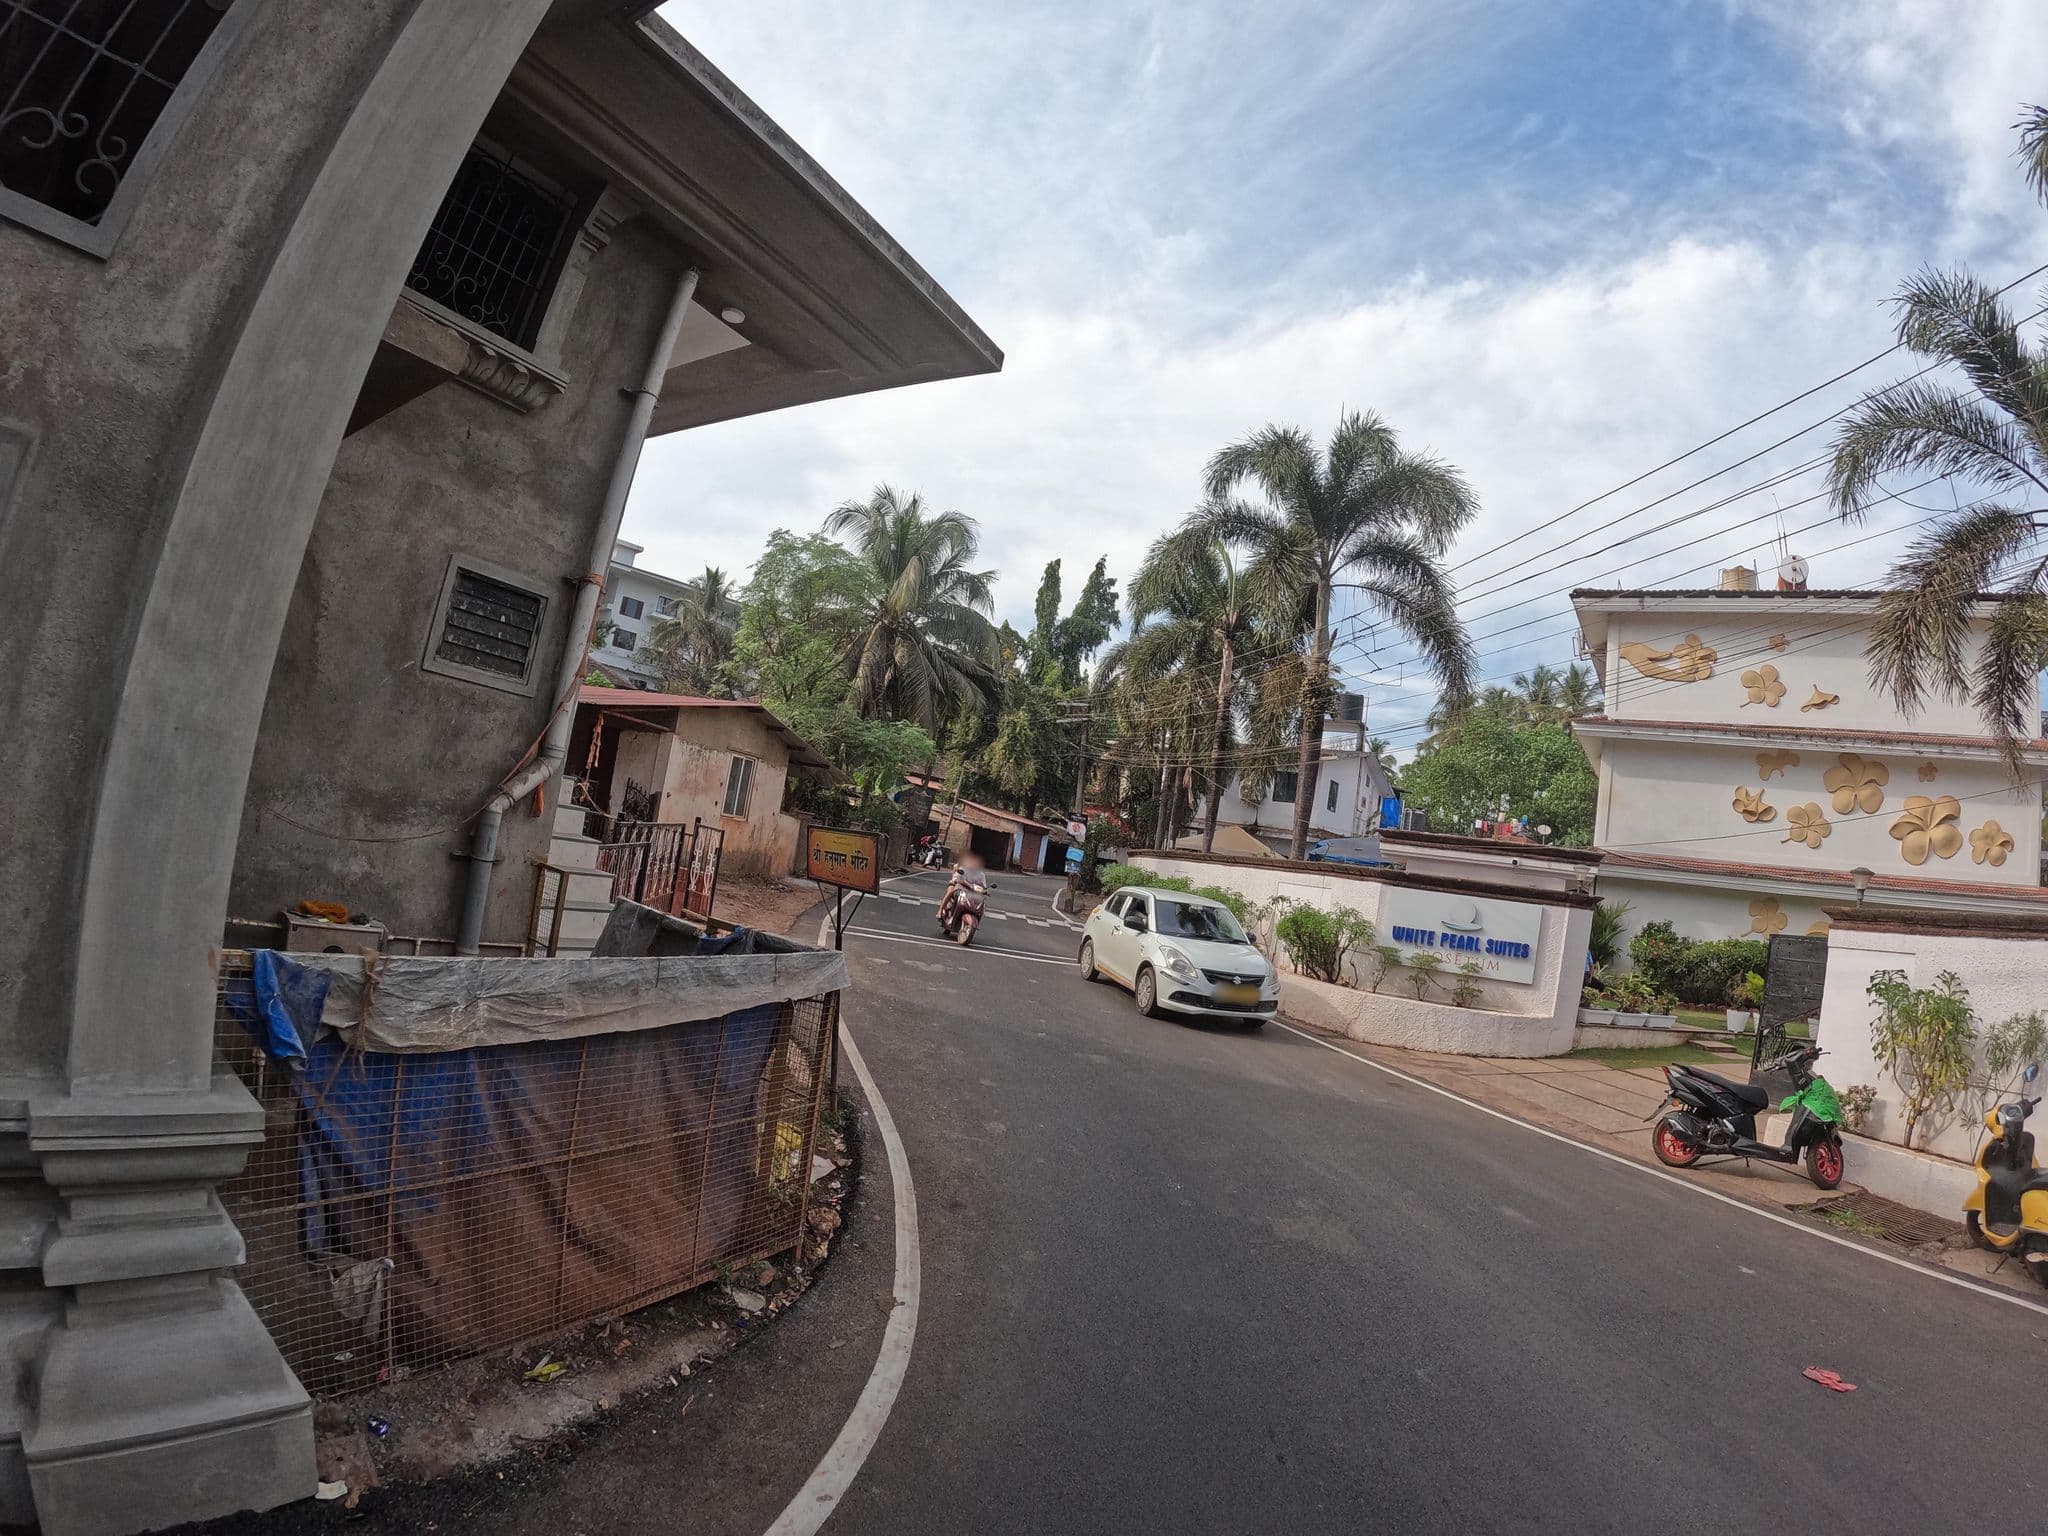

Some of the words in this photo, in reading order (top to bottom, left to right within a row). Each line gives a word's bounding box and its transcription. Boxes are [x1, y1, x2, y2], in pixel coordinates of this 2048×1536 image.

[824, 850, 847, 871] हनुमान
[850, 849, 869, 871] मंदिर
[1392, 925, 1435, 946] WHITE
[1440, 932, 1481, 953] PEARL
[1485, 938, 1530, 959] SUITES
